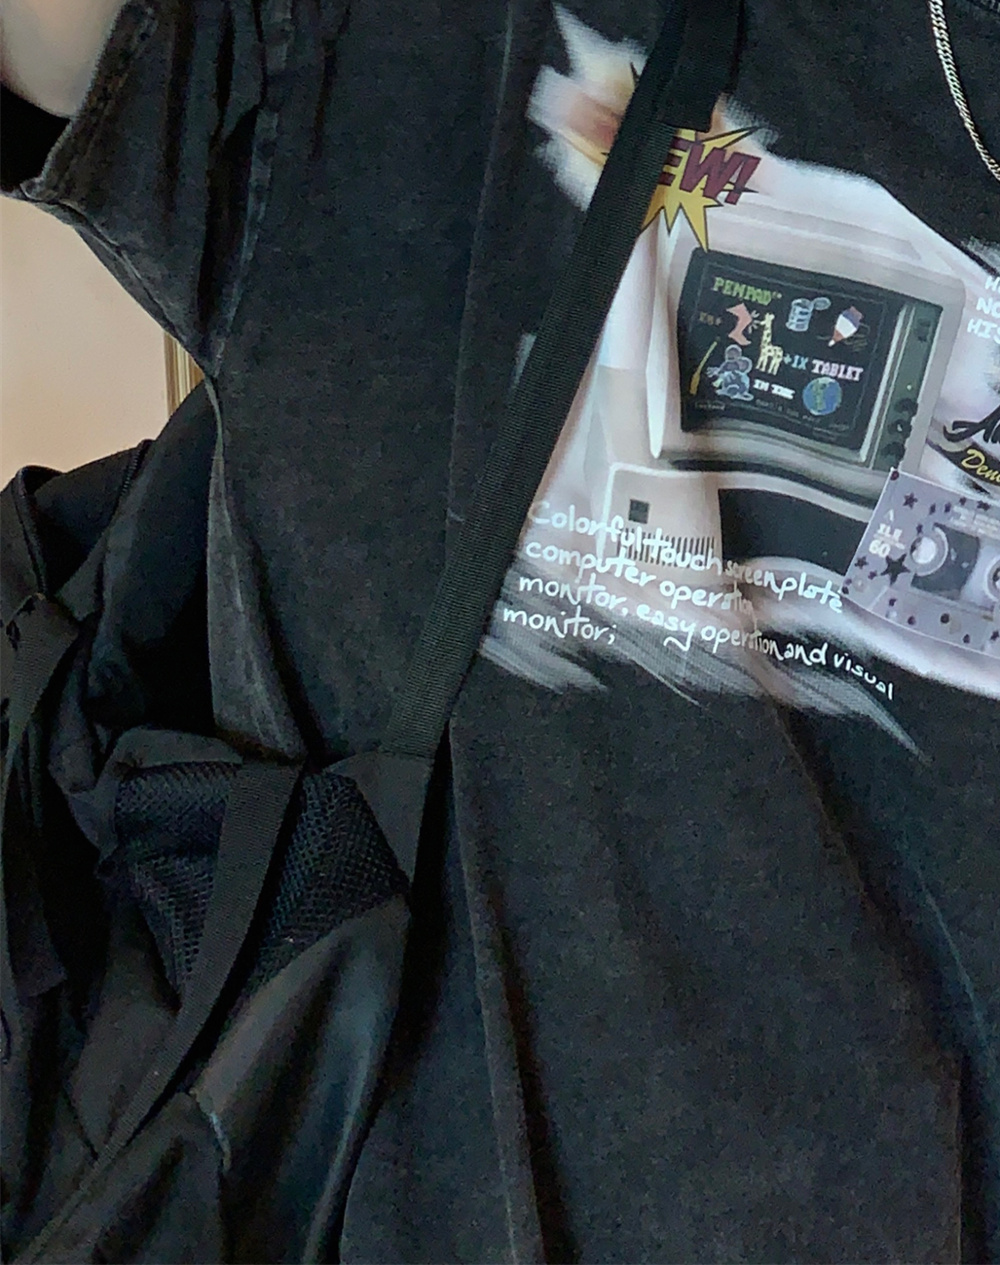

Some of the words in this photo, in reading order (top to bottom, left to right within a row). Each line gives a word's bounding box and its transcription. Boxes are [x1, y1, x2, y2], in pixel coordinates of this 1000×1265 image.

[656, 136, 761, 206] EW!
[526, 540, 657, 586] computer
[528, 500, 643, 553] Colorful
[642, 527, 726, 576] touch
[777, 572, 843, 614] plate
[637, 603, 697, 652] easy
[783, 642, 829, 667] and
[833, 651, 894, 701] visual
